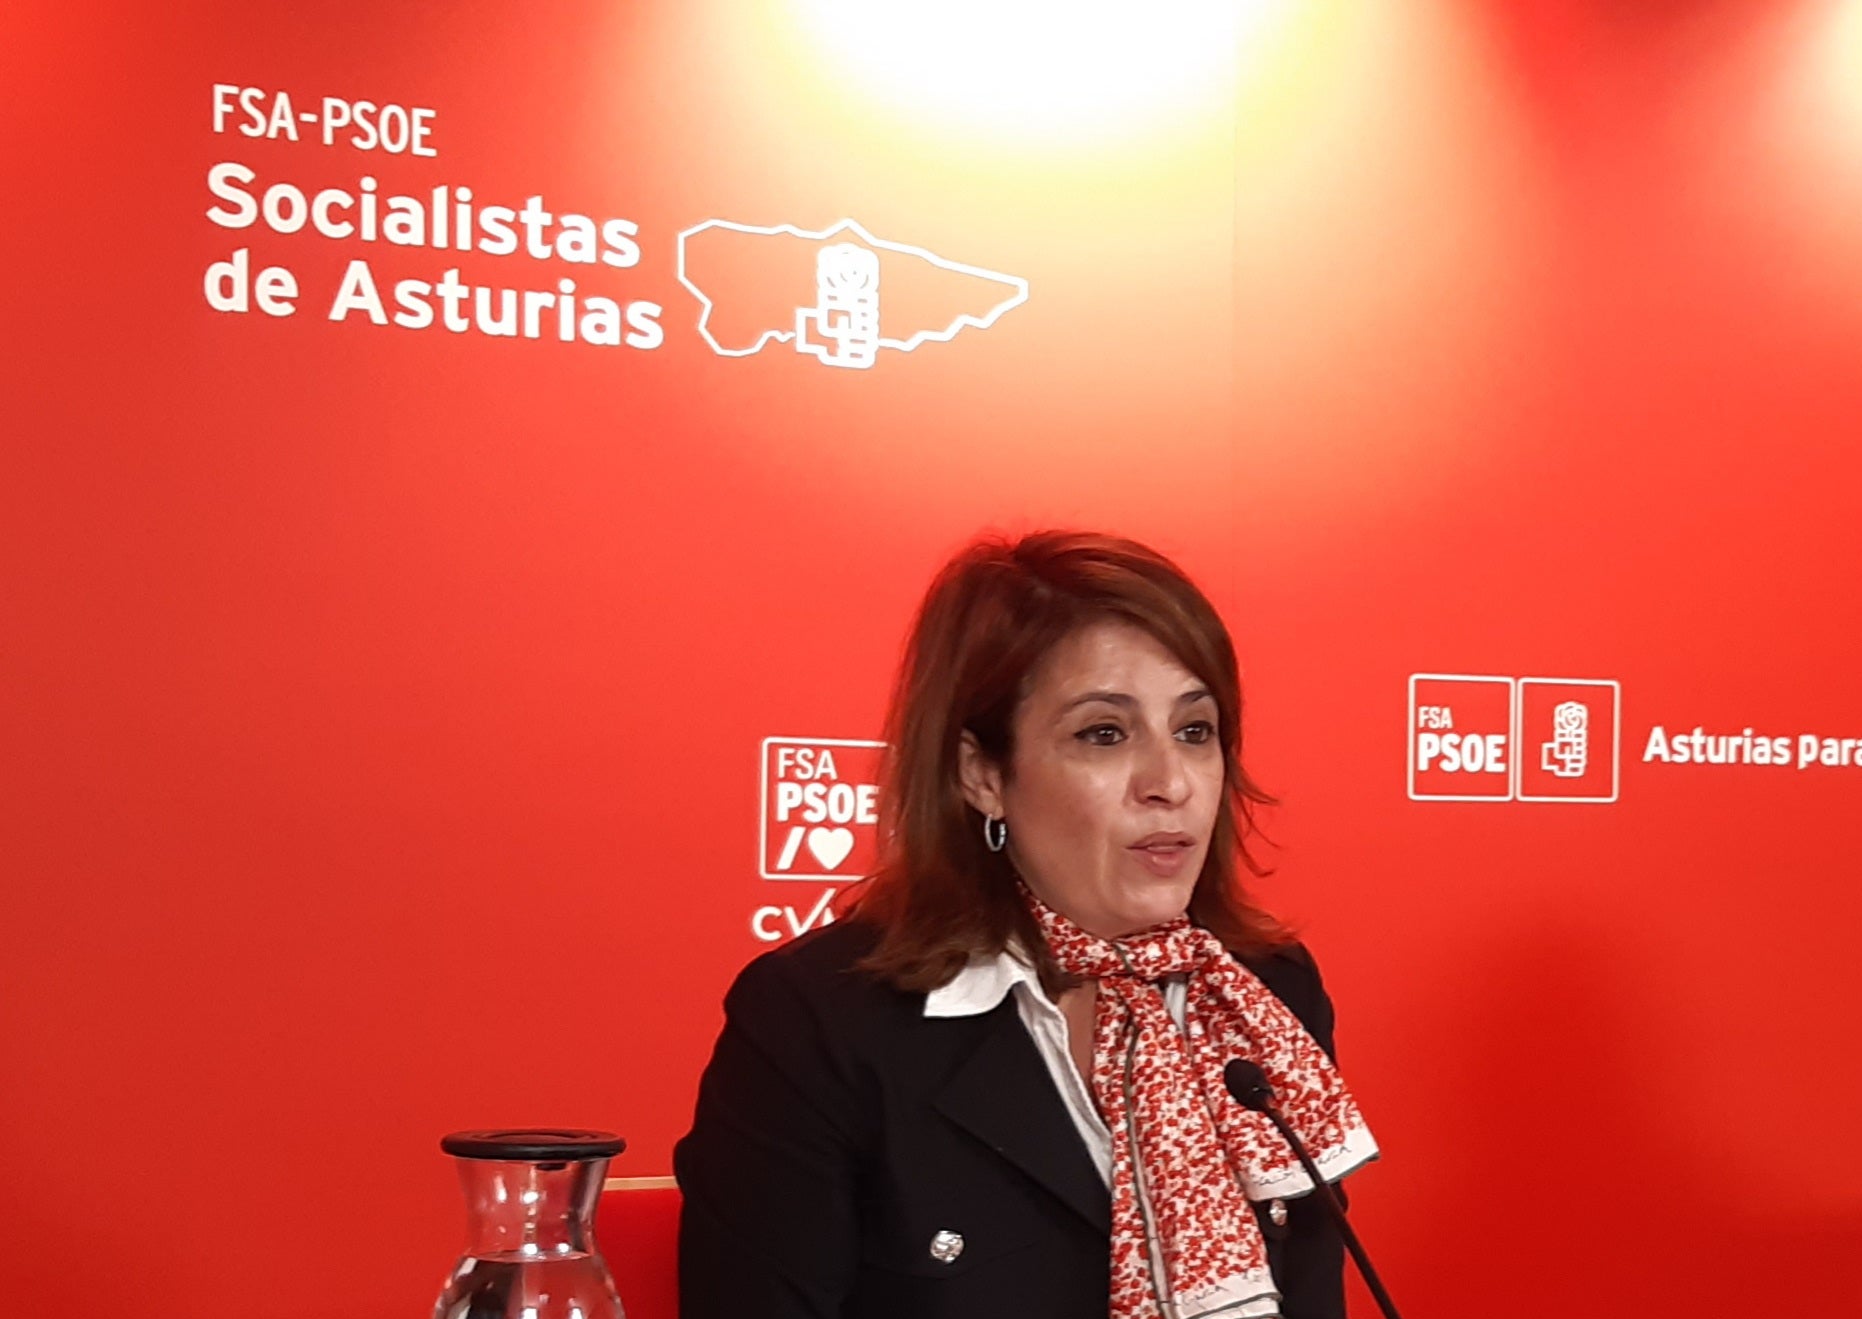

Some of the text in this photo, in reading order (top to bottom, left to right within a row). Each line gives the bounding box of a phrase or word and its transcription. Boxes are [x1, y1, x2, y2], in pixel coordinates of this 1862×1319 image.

[212, 83, 438, 157] FSA-PSOE
[205, 162, 642, 269] Socialistas
[203, 247, 665, 351] de Asturias
[1418, 705, 1453, 729] FSA
[776, 746, 838, 781] FSA
[1417, 732, 1507, 773] PSOE
[1642, 726, 1792, 765] Asturias
[775, 781, 881, 824] PSOE
